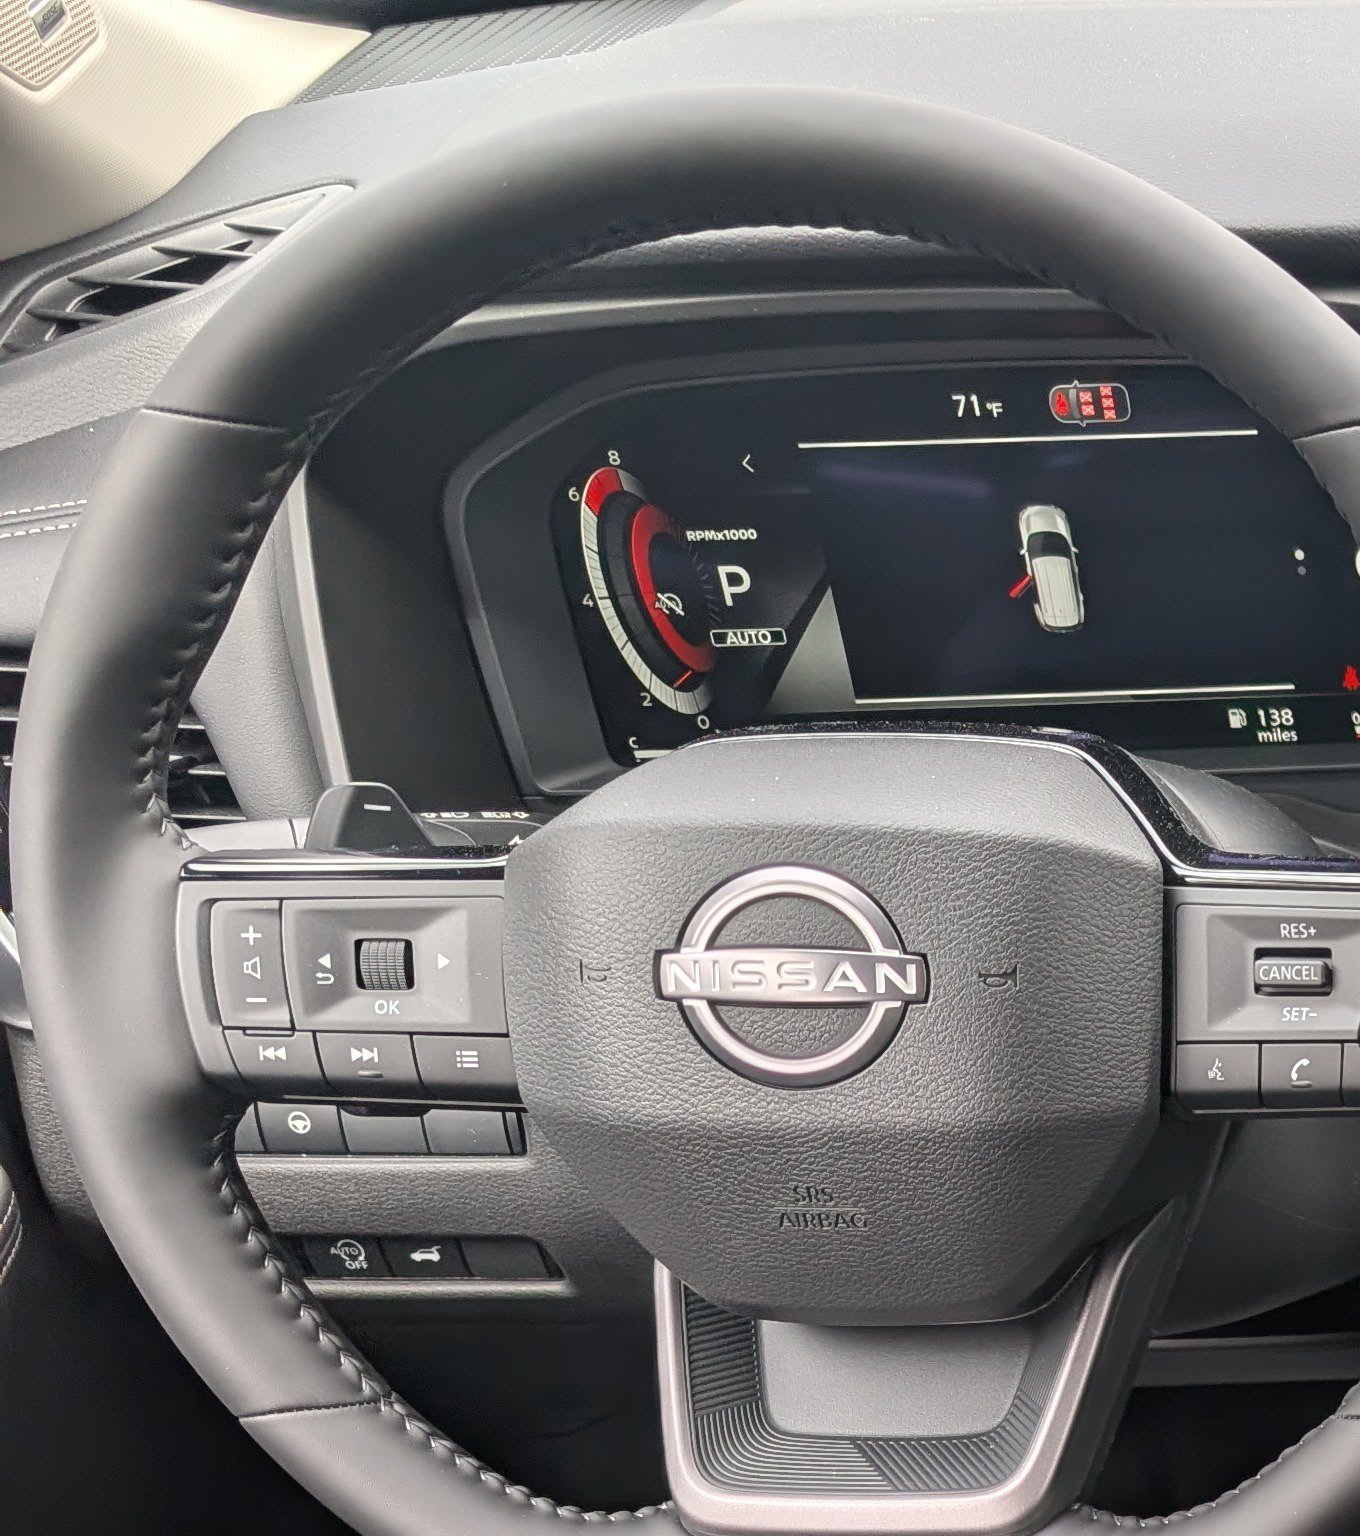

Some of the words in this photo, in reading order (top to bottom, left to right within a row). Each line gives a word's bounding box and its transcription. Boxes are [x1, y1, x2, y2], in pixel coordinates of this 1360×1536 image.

[607, 450, 621, 466] 8
[568, 486, 580, 502] 6
[685, 528, 758, 542] RPMx1000
[717, 564, 752, 607] P
[582, 593, 595, 608] 4
[726, 629, 772, 646] AUTO
[640, 693, 653, 707] 2
[697, 715, 710, 730] 0
[1257, 708, 1295, 728] 138
[1257, 728, 1299, 744] miles
[1280, 922, 1317, 940] RES+
[665, 957, 918, 997] NISSAN
[1258, 964, 1318, 983] CANCEL
[374, 1000, 401, 1016] OK
[791, 1184, 834, 1205] SRS
[778, 1211, 868, 1230] AIRBAG
[330, 1246, 359, 1257] AUTO
[344, 1259, 369, 1271] OFF
